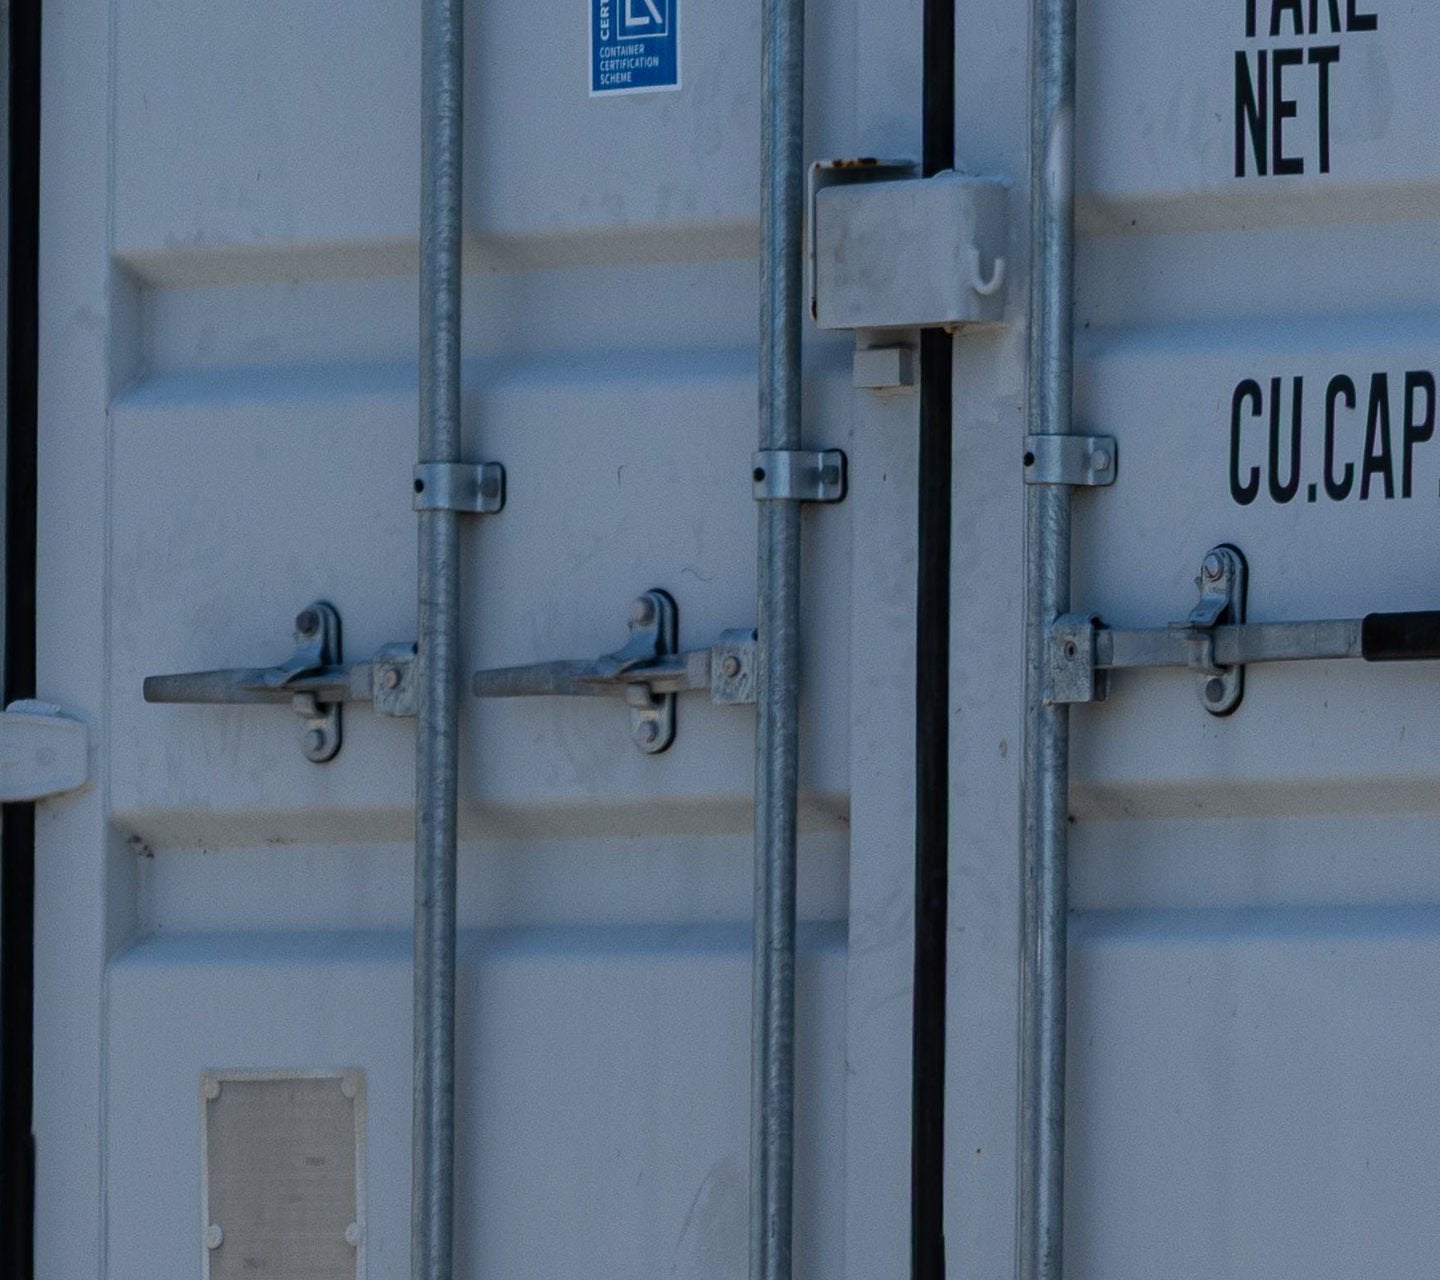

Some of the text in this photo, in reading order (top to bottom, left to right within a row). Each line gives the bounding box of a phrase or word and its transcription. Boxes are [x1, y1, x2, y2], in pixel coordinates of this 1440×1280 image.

[599, 44, 645, 58] CONTAINER
[599, 57, 659, 72] CERTIFICATION
[599, 71, 632, 85] SCHEME
[1234, 45, 1341, 178] NET
[1229, 370, 1440, 506] CU.CAP
